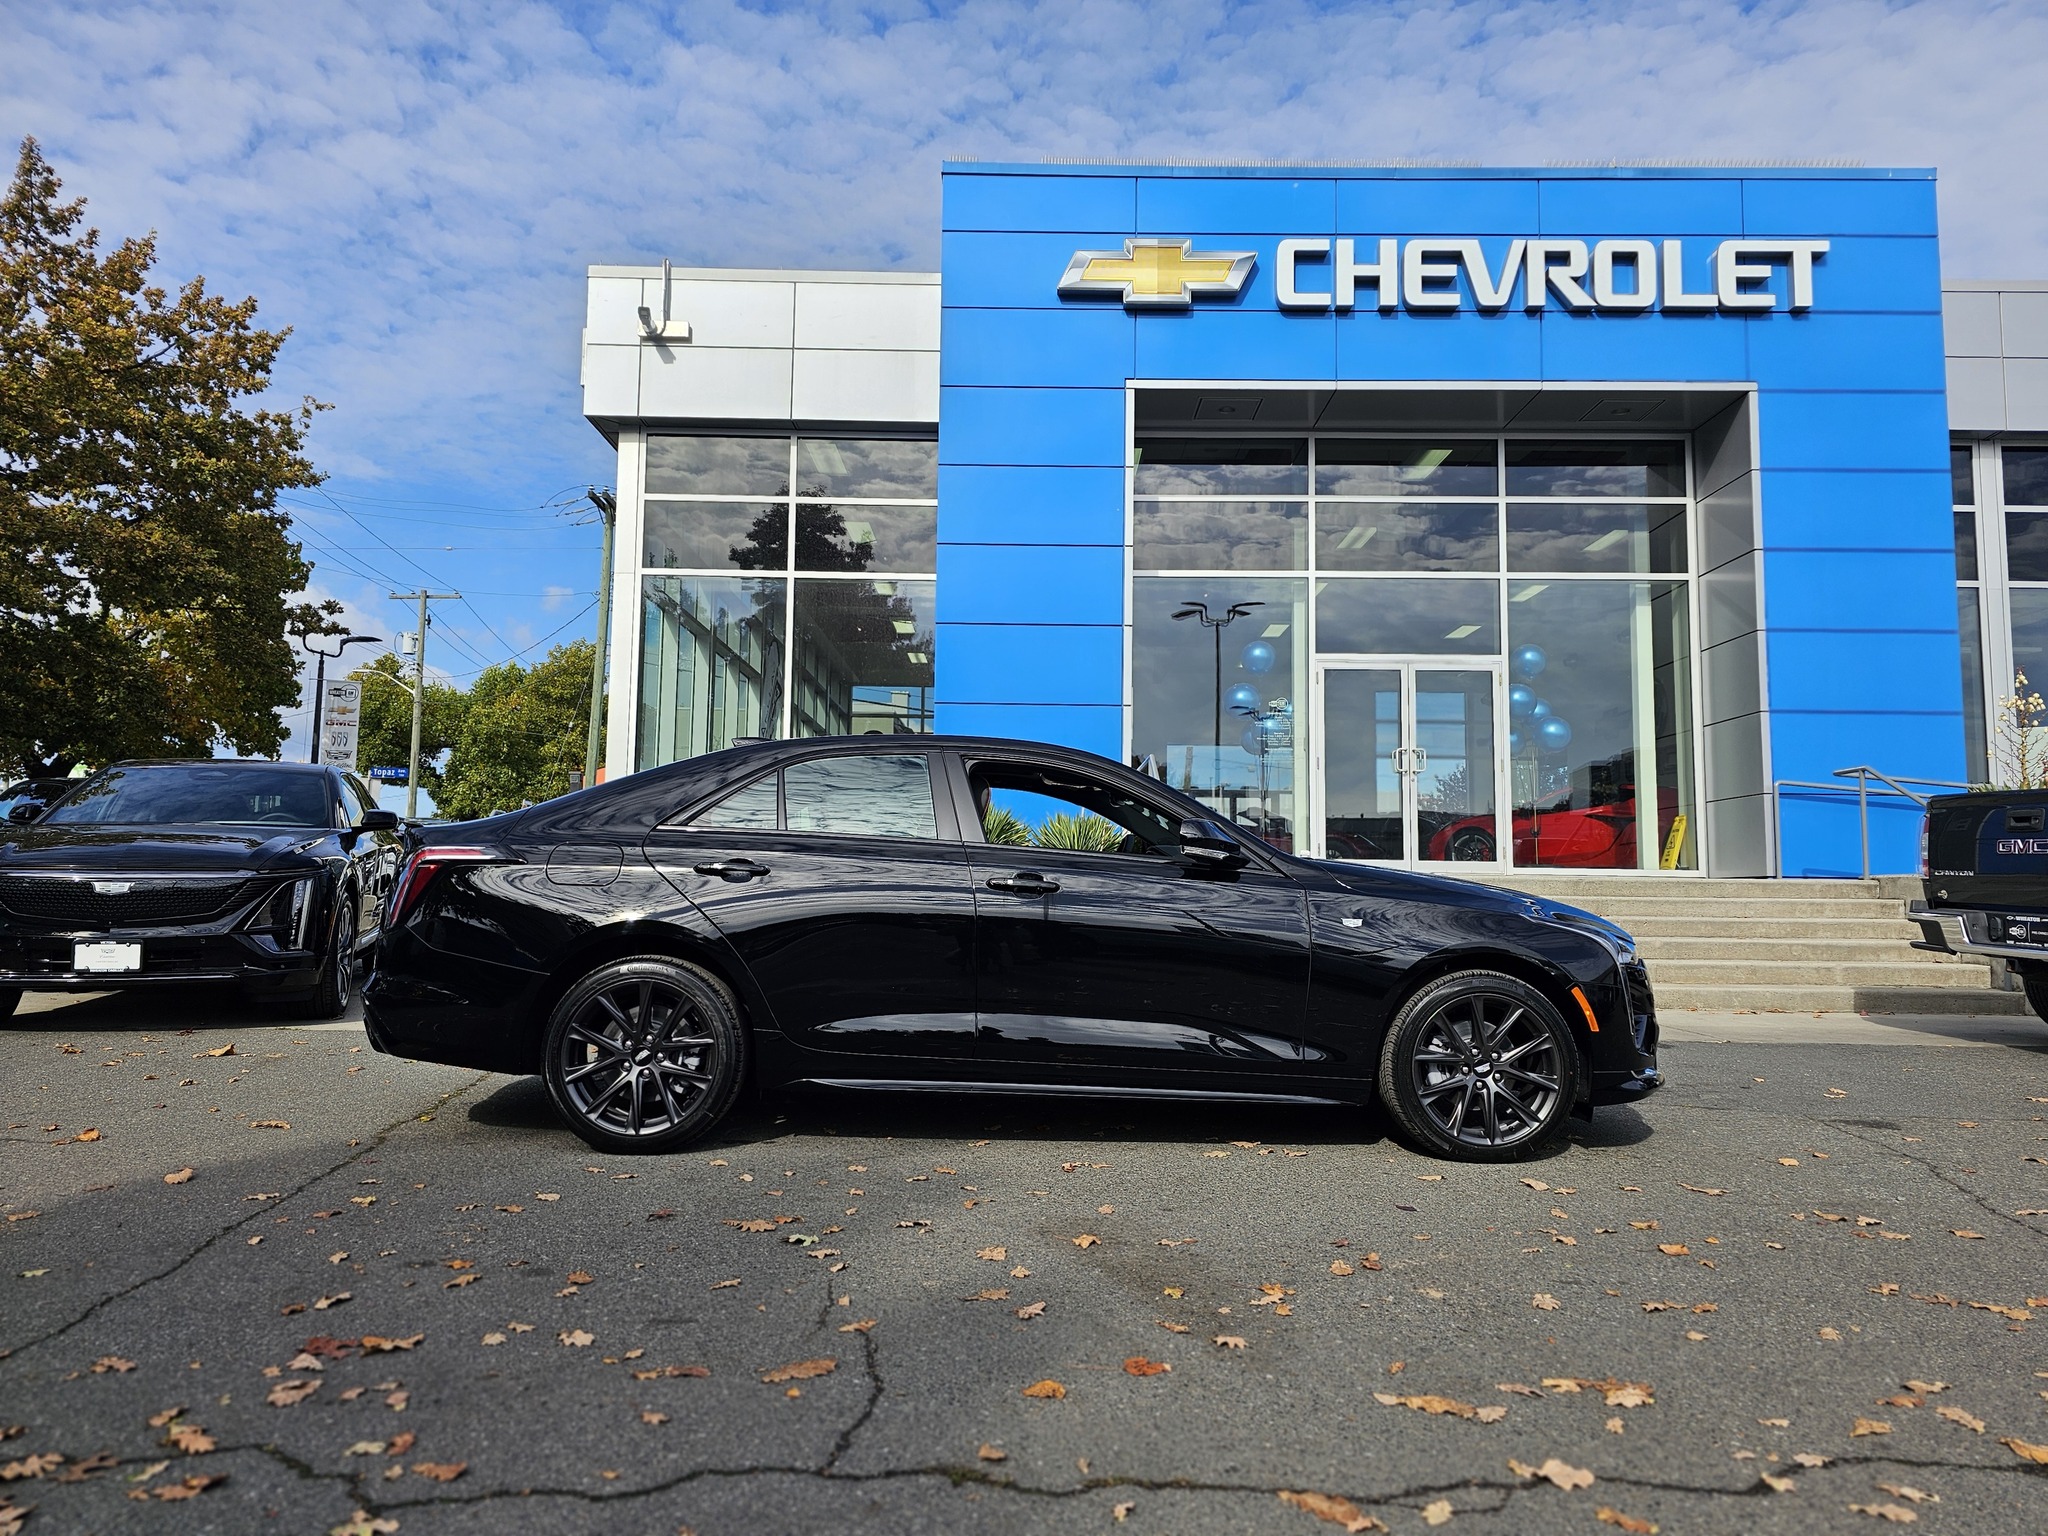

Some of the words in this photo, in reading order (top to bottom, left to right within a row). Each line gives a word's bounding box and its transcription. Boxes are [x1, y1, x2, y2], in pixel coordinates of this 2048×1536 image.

[1275, 237, 1831, 311] CHEVROLET
[326, 719, 357, 727] GMC
[373, 768, 396, 778] Topaz
[1997, 838, 2048, 855] GMC
